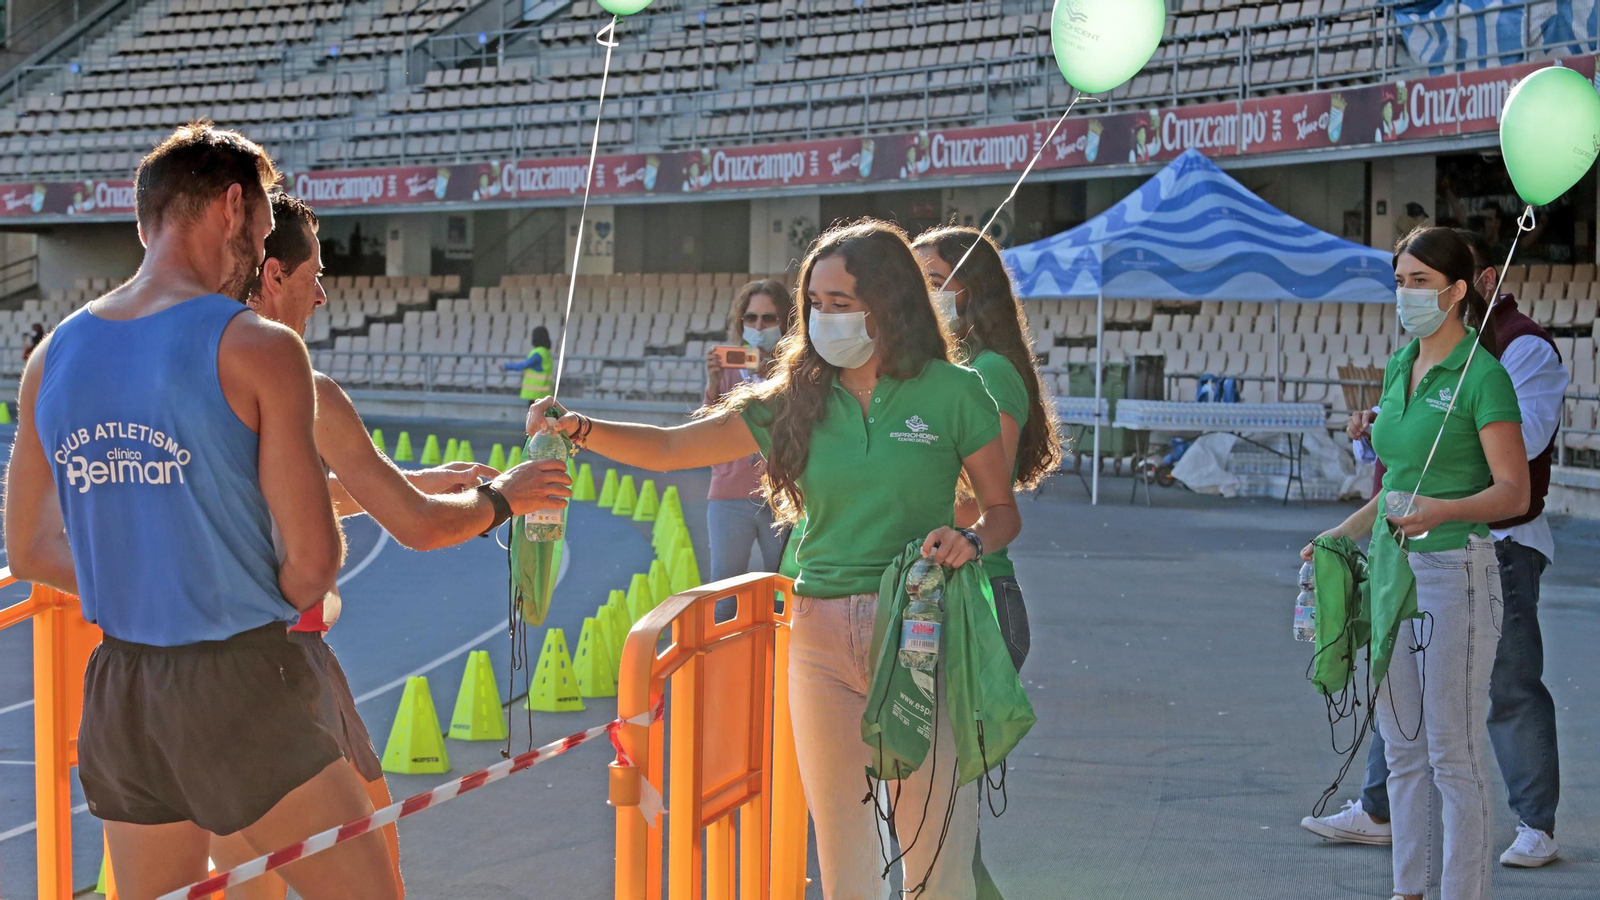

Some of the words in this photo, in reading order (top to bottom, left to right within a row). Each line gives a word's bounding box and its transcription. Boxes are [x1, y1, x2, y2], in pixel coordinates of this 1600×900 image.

[1410, 78, 1518, 124] Cruzcamp
[1162, 110, 1267, 151] Cruzcampo
[1272, 109, 1282, 142] SIN
[713, 150, 806, 183] Cruzcampo
[809, 150, 819, 177] SIN
[931, 133, 1028, 170] Cruzcampo
[296, 173, 385, 203] Cruzcampo
[387, 174, 398, 198] SIN
[502, 162, 590, 194] Cruzcampo
[54, 427, 91, 465] CLUB
[94, 421, 192, 466] ATLETISMO
[106, 447, 142, 461] clínica
[66, 455, 185, 494] Beiman
